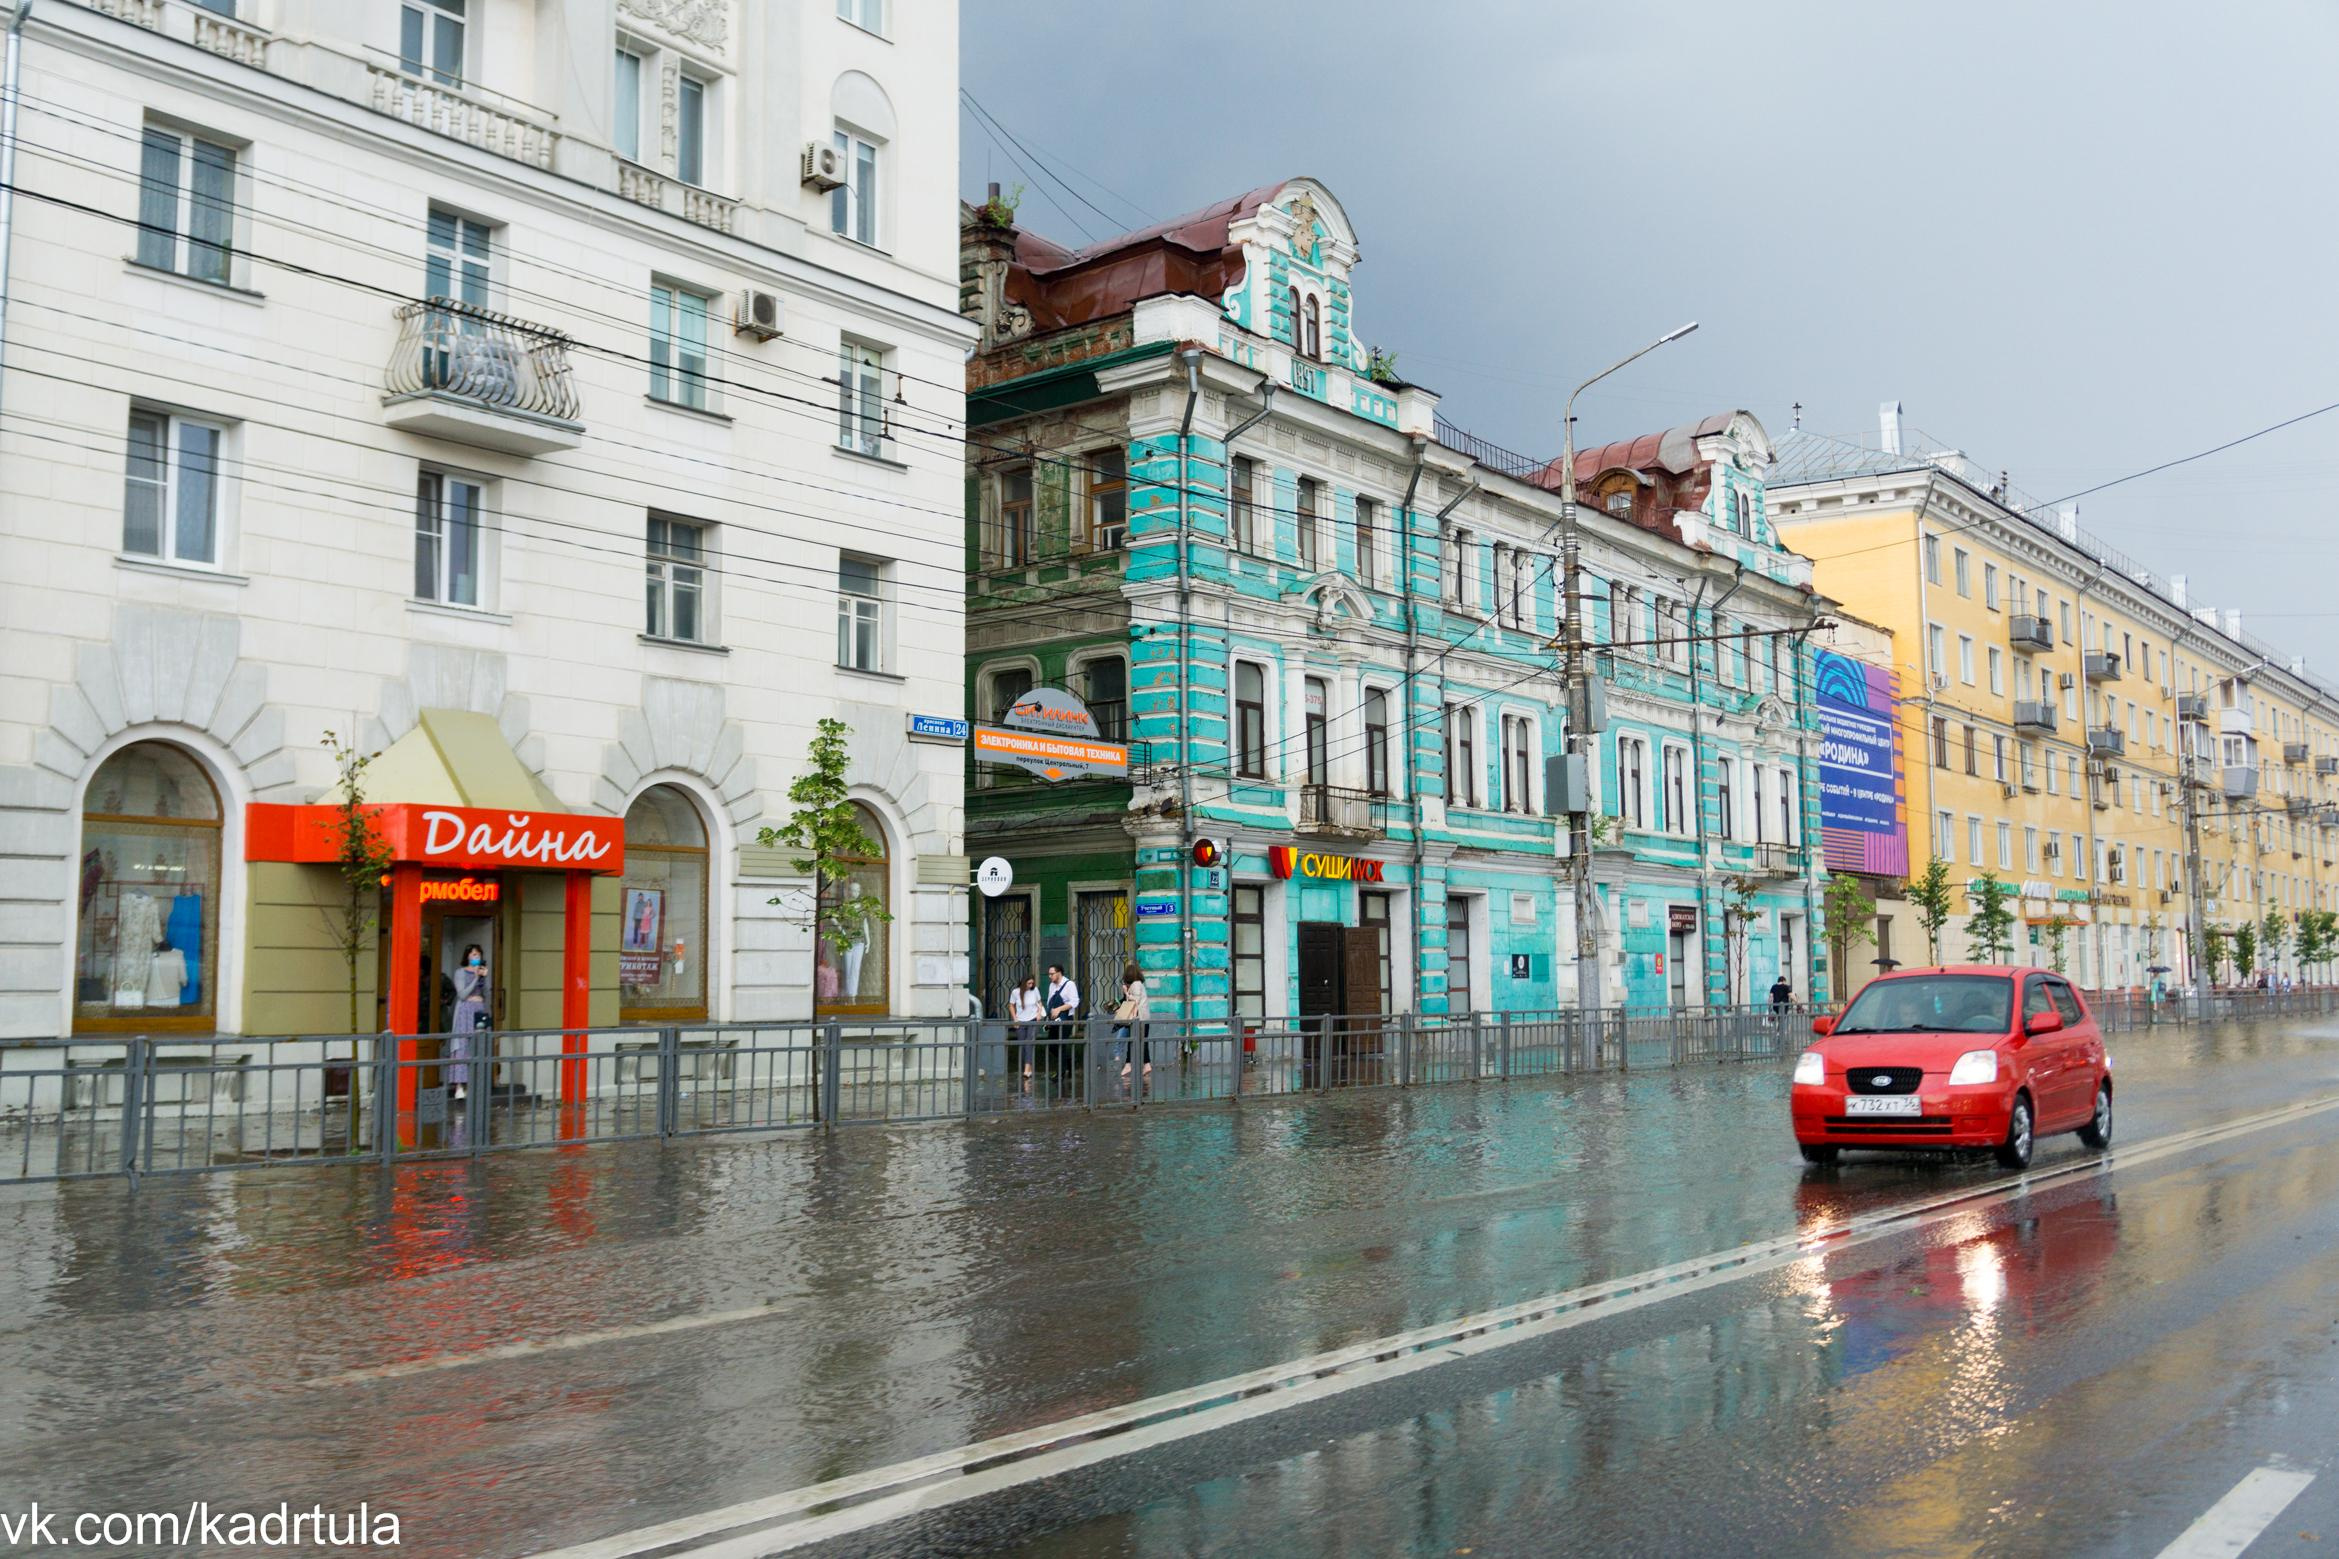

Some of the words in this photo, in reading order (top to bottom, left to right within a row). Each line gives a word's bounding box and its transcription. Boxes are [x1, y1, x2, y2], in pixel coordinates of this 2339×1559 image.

[916, 721, 951, 735] Ленина
[955, 723, 966, 736] 24
[980, 734, 1039, 752] ЭЛЕКТРОНИКА
[1039, 742, 1046, 752] И
[1046, 742, 1085, 758] БЫТОВАЯ
[1086, 748, 1121, 762] ТЕХНИКА
[1819, 741, 1869, 766] «РОДИНА»
[1016, 756, 1045, 766] переулок
[421, 811, 611, 863] Дайна
